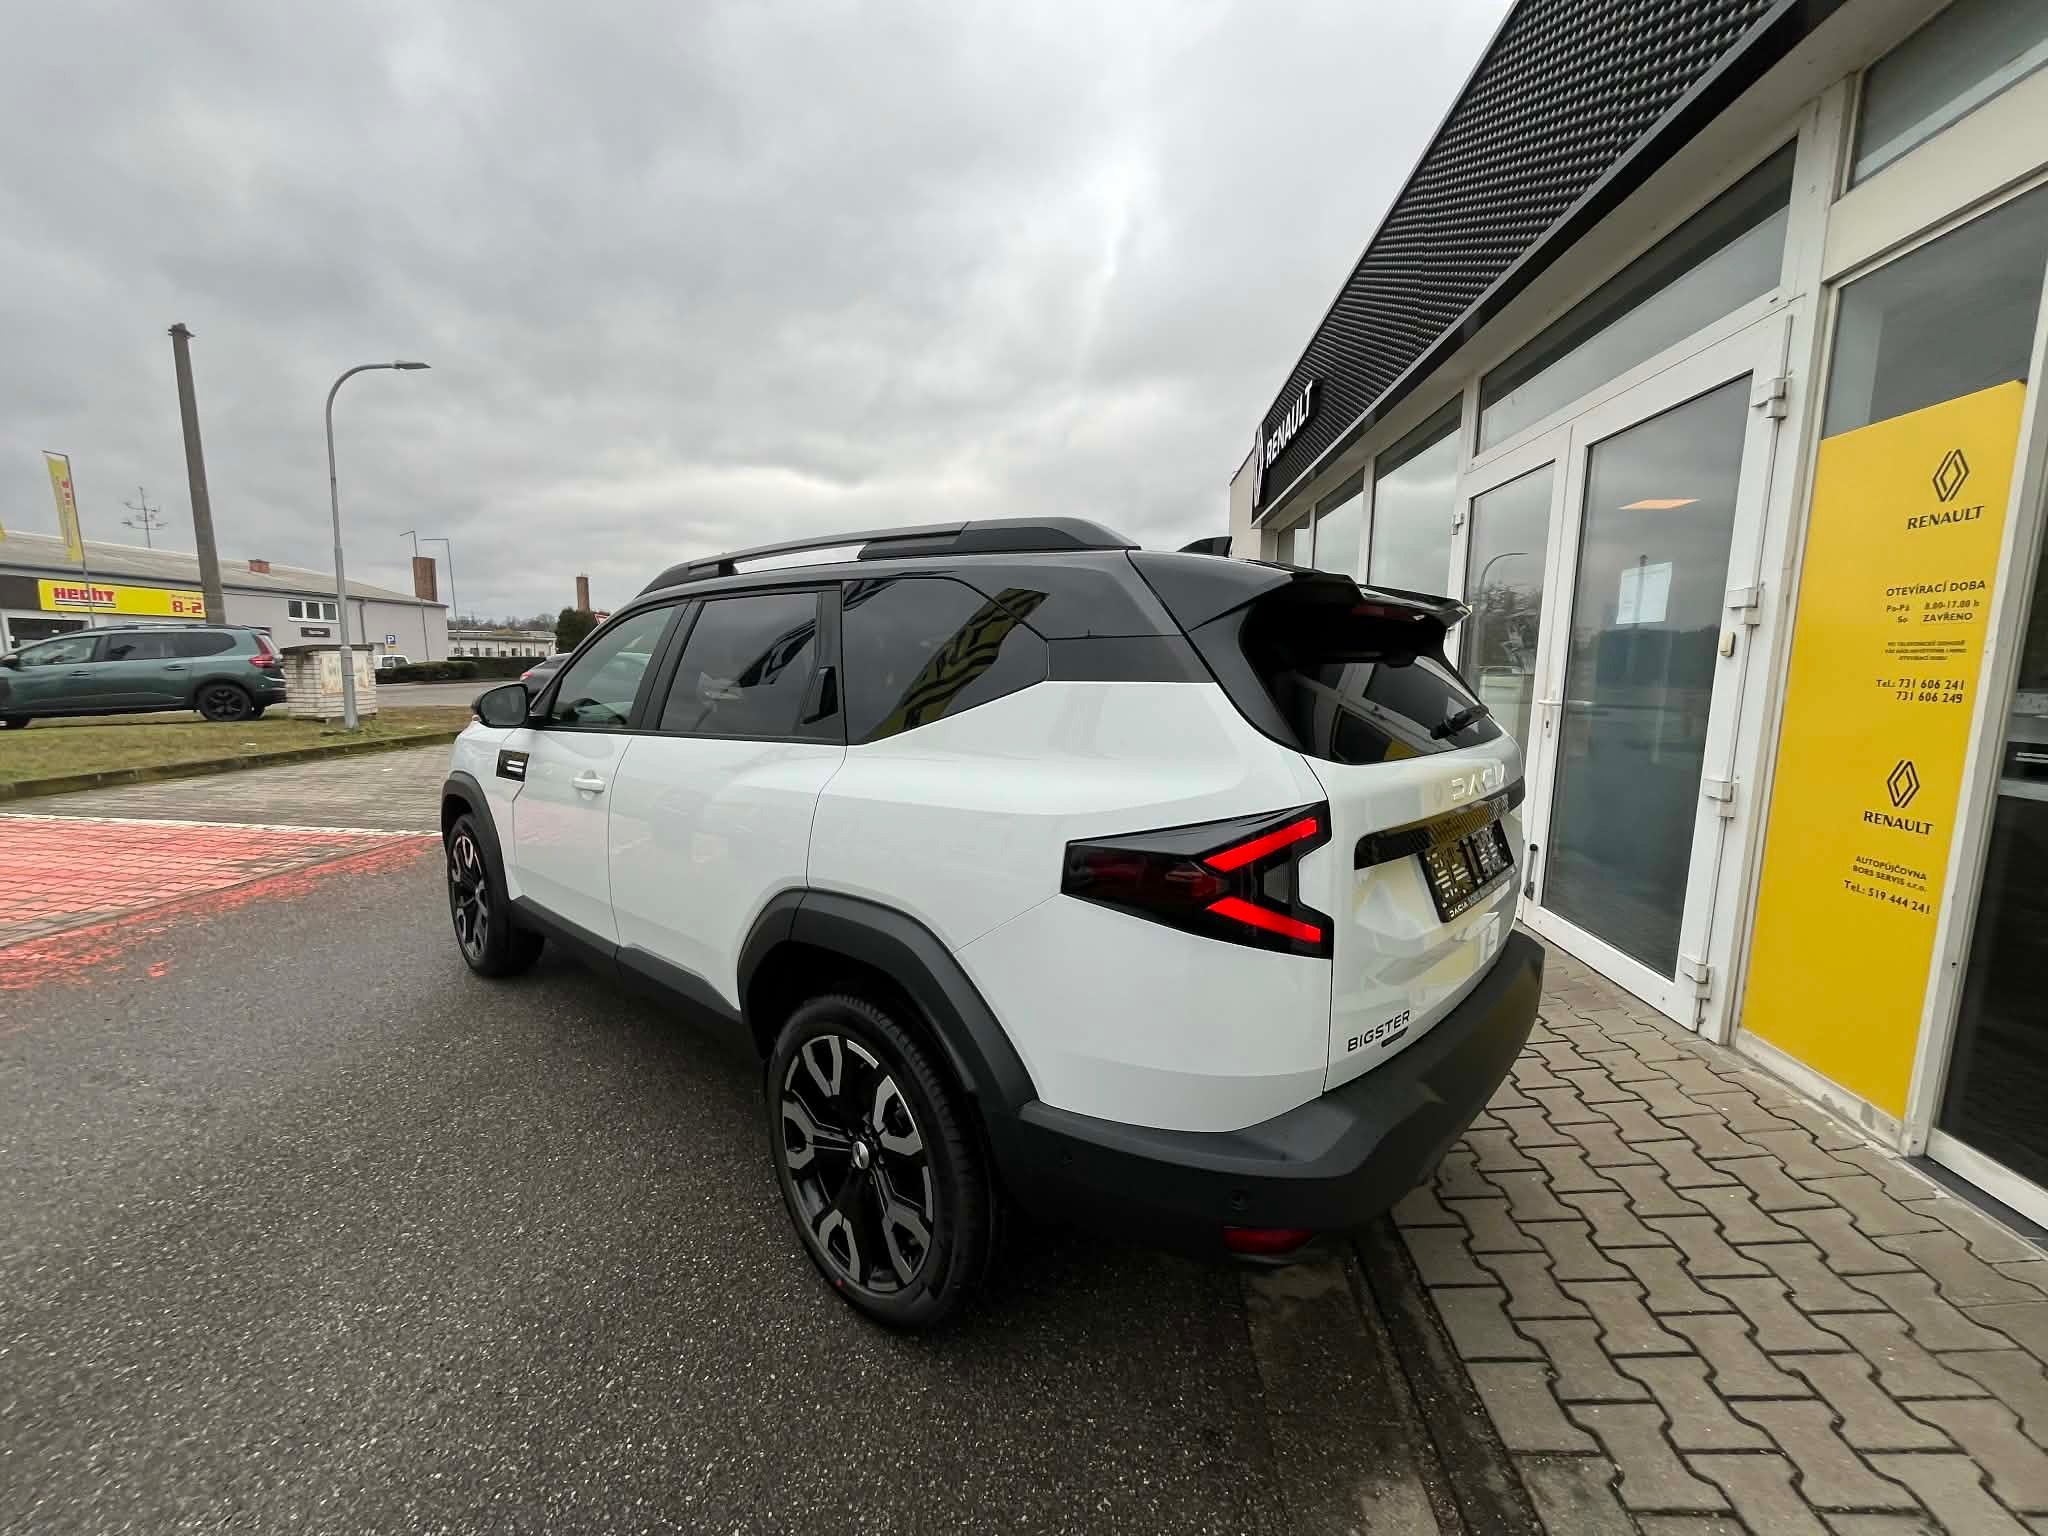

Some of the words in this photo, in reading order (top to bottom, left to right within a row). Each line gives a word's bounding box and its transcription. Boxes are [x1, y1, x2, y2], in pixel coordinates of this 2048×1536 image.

[1265, 379, 1313, 470] RENAULT
[1907, 505, 1984, 529] RENAULT
[1886, 580, 1946, 596] OTEVÍRACÍ
[1950, 580, 1985, 591] DOBA
[1922, 611, 1973, 621] ZAVŘENO
[1899, 678, 1916, 688] 731
[1920, 679, 1940, 689] 606
[1944, 679, 1964, 690] 241
[1896, 690, 1913, 700] 731
[1918, 691, 1938, 702] 606
[1863, 810, 1934, 835] RENAULT
[1876, 871, 1905, 885] SERVIS
[1868, 887, 1886, 900] 519
[1888, 895, 1908, 908] 444
[1911, 900, 1930, 914] 241
[1347, 1009, 1410, 1053] BIGSTER
